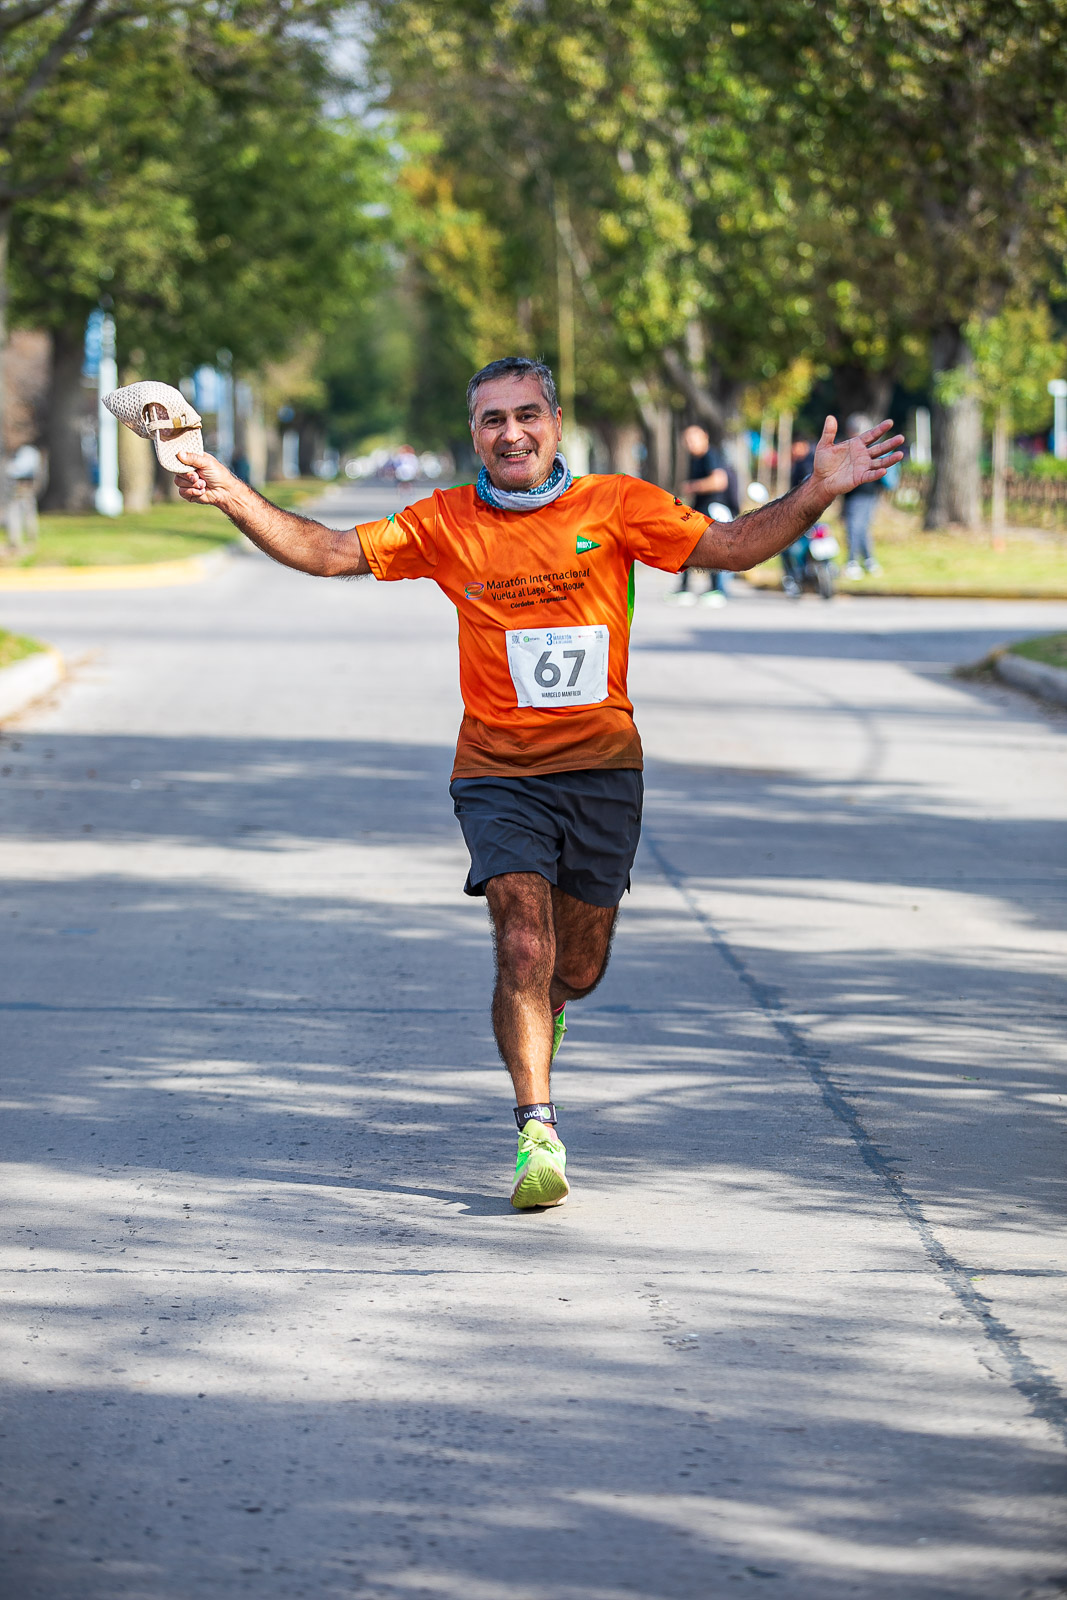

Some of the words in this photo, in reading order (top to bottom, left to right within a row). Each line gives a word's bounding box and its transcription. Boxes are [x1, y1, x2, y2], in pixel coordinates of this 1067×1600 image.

[486, 576, 527, 590] Maratón
[529, 568, 590, 584] Internacional
[491, 590, 517, 601] Vuelta
[518, 587, 526, 597] al
[526, 587, 546, 597] Lago
[547, 583, 561, 593] San
[562, 581, 585, 592] Roque
[546, 632, 553, 646] 3
[534, 649, 586, 688] 67
